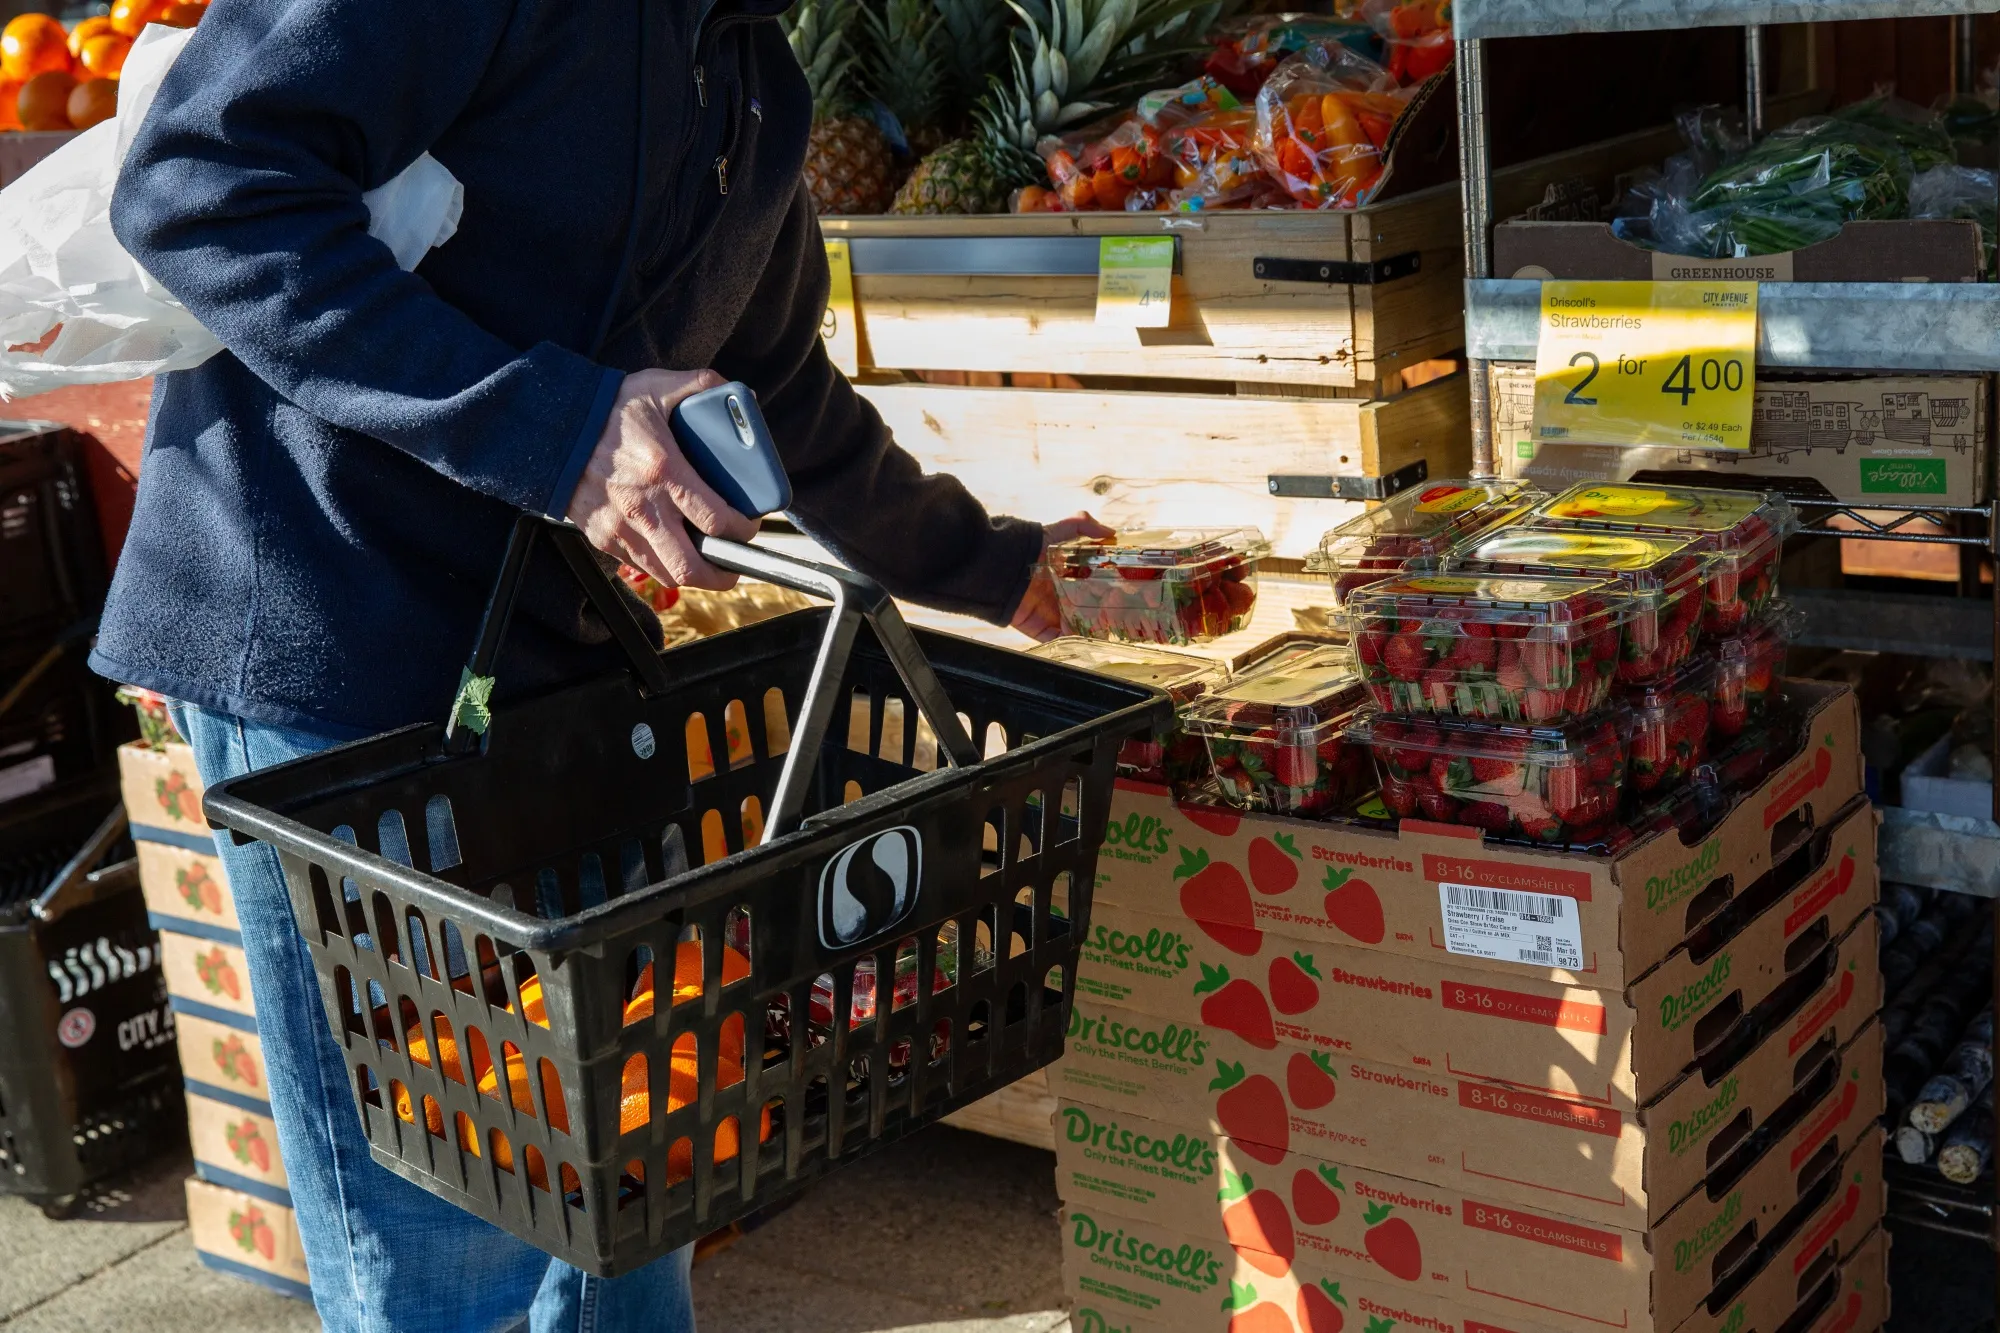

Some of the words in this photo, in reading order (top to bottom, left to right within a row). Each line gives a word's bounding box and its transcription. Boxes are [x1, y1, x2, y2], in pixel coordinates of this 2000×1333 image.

[1671, 267, 1775, 279] GREENHOUSE
[1550, 297, 1596, 308] Driscoll's
[1703, 292, 1719, 303] CITY
[1721, 293, 1748, 304] AVENUE
[1550, 313, 1642, 330] Strawberries
[1564, 351, 1600, 405] 2
[1617, 353, 1648, 375] for
[1682, 421, 1693, 430] Or
[1696, 421, 1719, 431] $2.49
[1721, 423, 1742, 432] Each
[1682, 432, 1697, 441] Per
[1703, 433, 1724, 443] 454g
[1560, 467, 1607, 482] naturally
[1868, 465, 1938, 488] Village
[1311, 844, 1414, 873] Strawberries
[1436, 861, 1475, 880] 8-16
[1479, 872, 1495, 883] OZ
[1498, 875, 1576, 893] CLAMSHELLS
[1447, 910, 1480, 921] Strawberry
[1485, 914, 1504, 923] Fraise
[1103, 955, 1134, 971] Finest
[1135, 961, 1174, 979] Berries
[1331, 967, 1433, 1000] Strawberries
[1455, 989, 1493, 1009] 8-16
[1660, 951, 1731, 1028] Driscoll's
[1073, 1041, 1097, 1057] Only
[1099, 1048, 1116, 1060] the
[1117, 1052, 1149, 1067] Finest
[1152, 1058, 1189, 1076] Berries
[1350, 1064, 1449, 1098] Strawberries
[1471, 1088, 1508, 1110] 8-16
[1512, 1102, 1529, 1114] OZ
[1530, 1105, 1606, 1129] CLAMSHELLS
[1668, 1075, 1740, 1154] Driscoll's
[1062, 1107, 1215, 1176] Driscoll's
[1083, 1147, 1107, 1164] Only
[1108, 1154, 1125, 1167] the
[1127, 1158, 1160, 1175] Finest
[1161, 1167, 1198, 1185] Berries
[1427, 1154, 1446, 1165] CAT-1
[1354, 1181, 1453, 1217] Strawberries
[1475, 1208, 1512, 1229] 8-16
[1516, 1222, 1532, 1234] OZ
[1533, 1226, 1607, 1253] CLAMSHELLS
[1070, 1212, 1220, 1286] Driscoll's
[1090, 1252, 1115, 1270] Only
[1114, 1260, 1132, 1274] the
[1133, 1265, 1165, 1283] Finest
[1166, 1274, 1203, 1294] Berries
[1358, 1296, 1455, 1333] Strawberries
